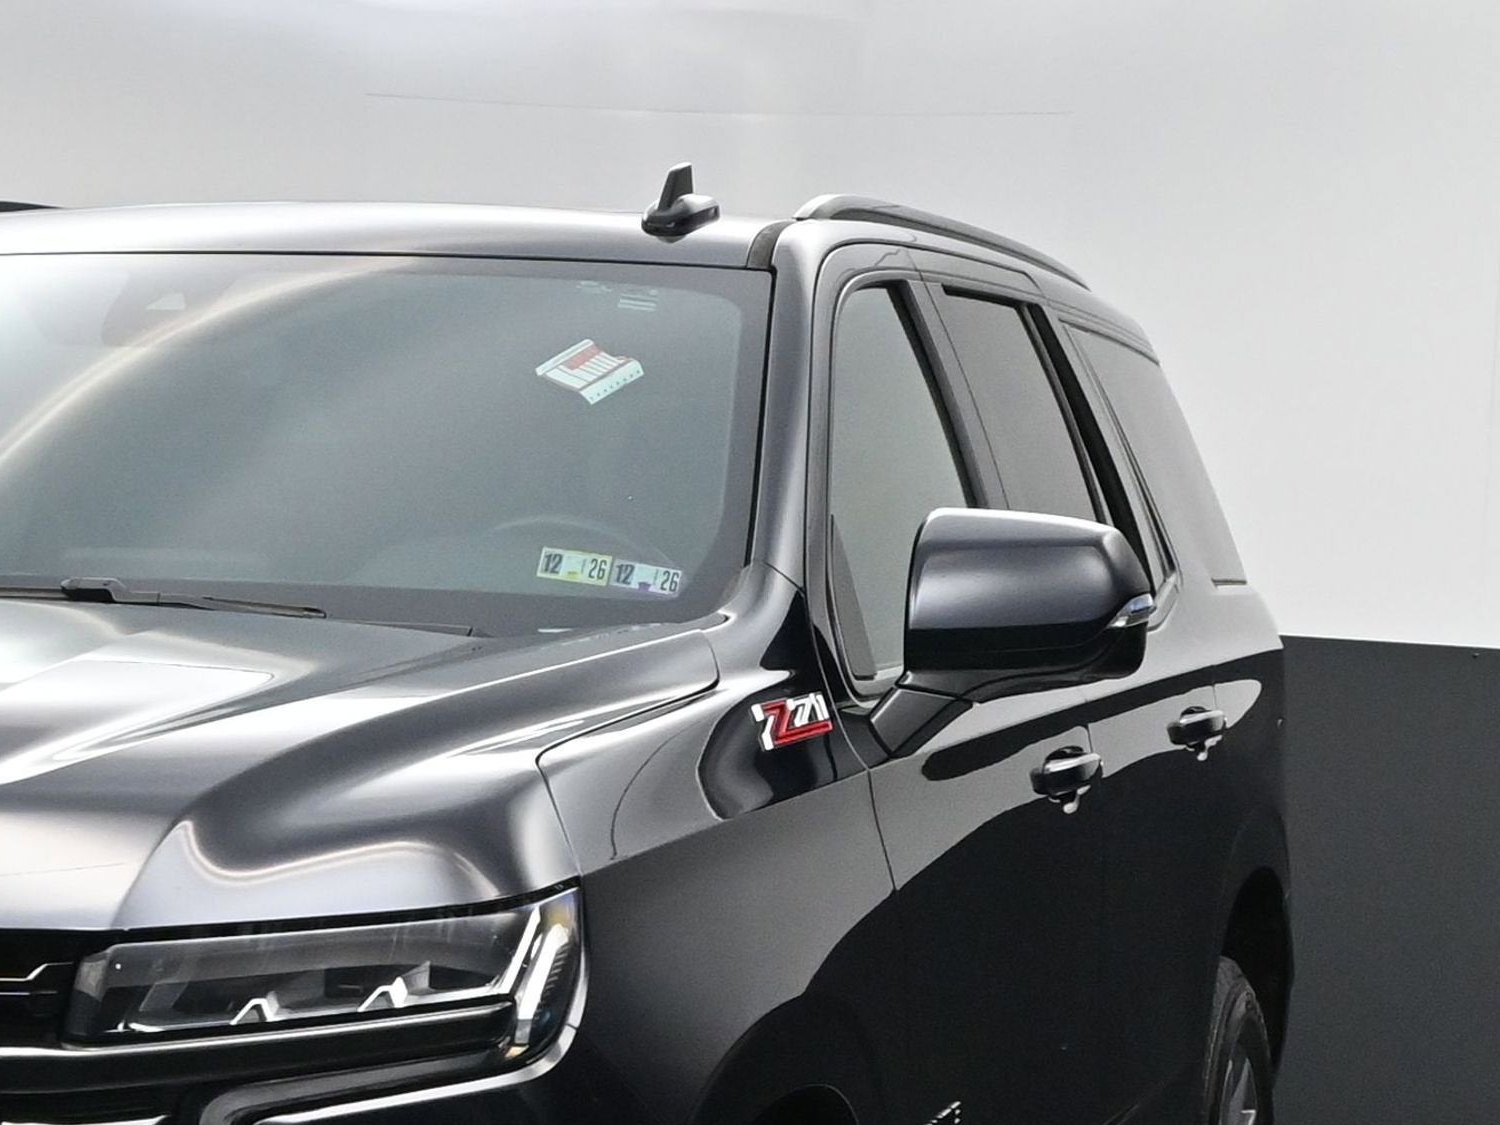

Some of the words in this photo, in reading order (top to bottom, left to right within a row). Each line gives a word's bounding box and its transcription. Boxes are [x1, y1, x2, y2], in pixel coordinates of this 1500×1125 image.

[543, 553, 563, 575] 12
[587, 558, 608, 581] 26
[615, 563, 635, 586] 12
[659, 570, 680, 593] 26
[750, 692, 834, 751] Z71
